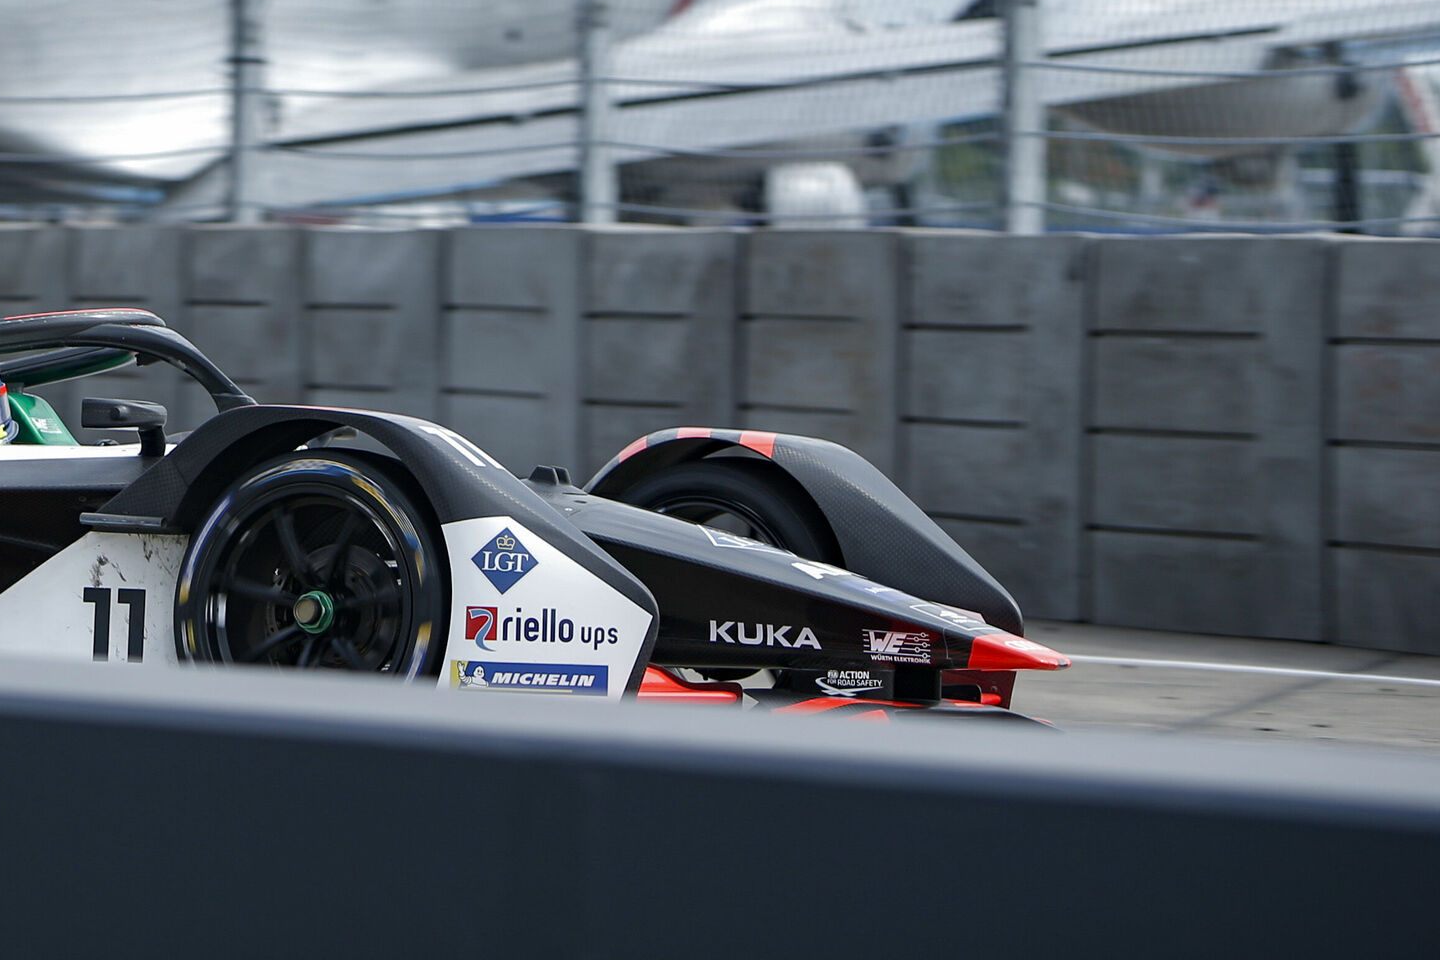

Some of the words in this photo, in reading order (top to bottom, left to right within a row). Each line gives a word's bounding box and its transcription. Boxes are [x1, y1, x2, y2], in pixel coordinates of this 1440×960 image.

[481, 551, 529, 573] LGT
[83, 587, 146, 663] 11
[503, 607, 574, 643] riello
[580, 626, 619, 650] ups
[709, 620, 823, 650] KUKA
[869, 630, 908, 653] WE
[870, 654, 893, 662] WÜRTH
[491, 672, 595, 688] MICHELIN
[837, 679, 856, 687] ROAD
[856, 679, 883, 687] SAFETY
[839, 670, 870, 680] ACTION
